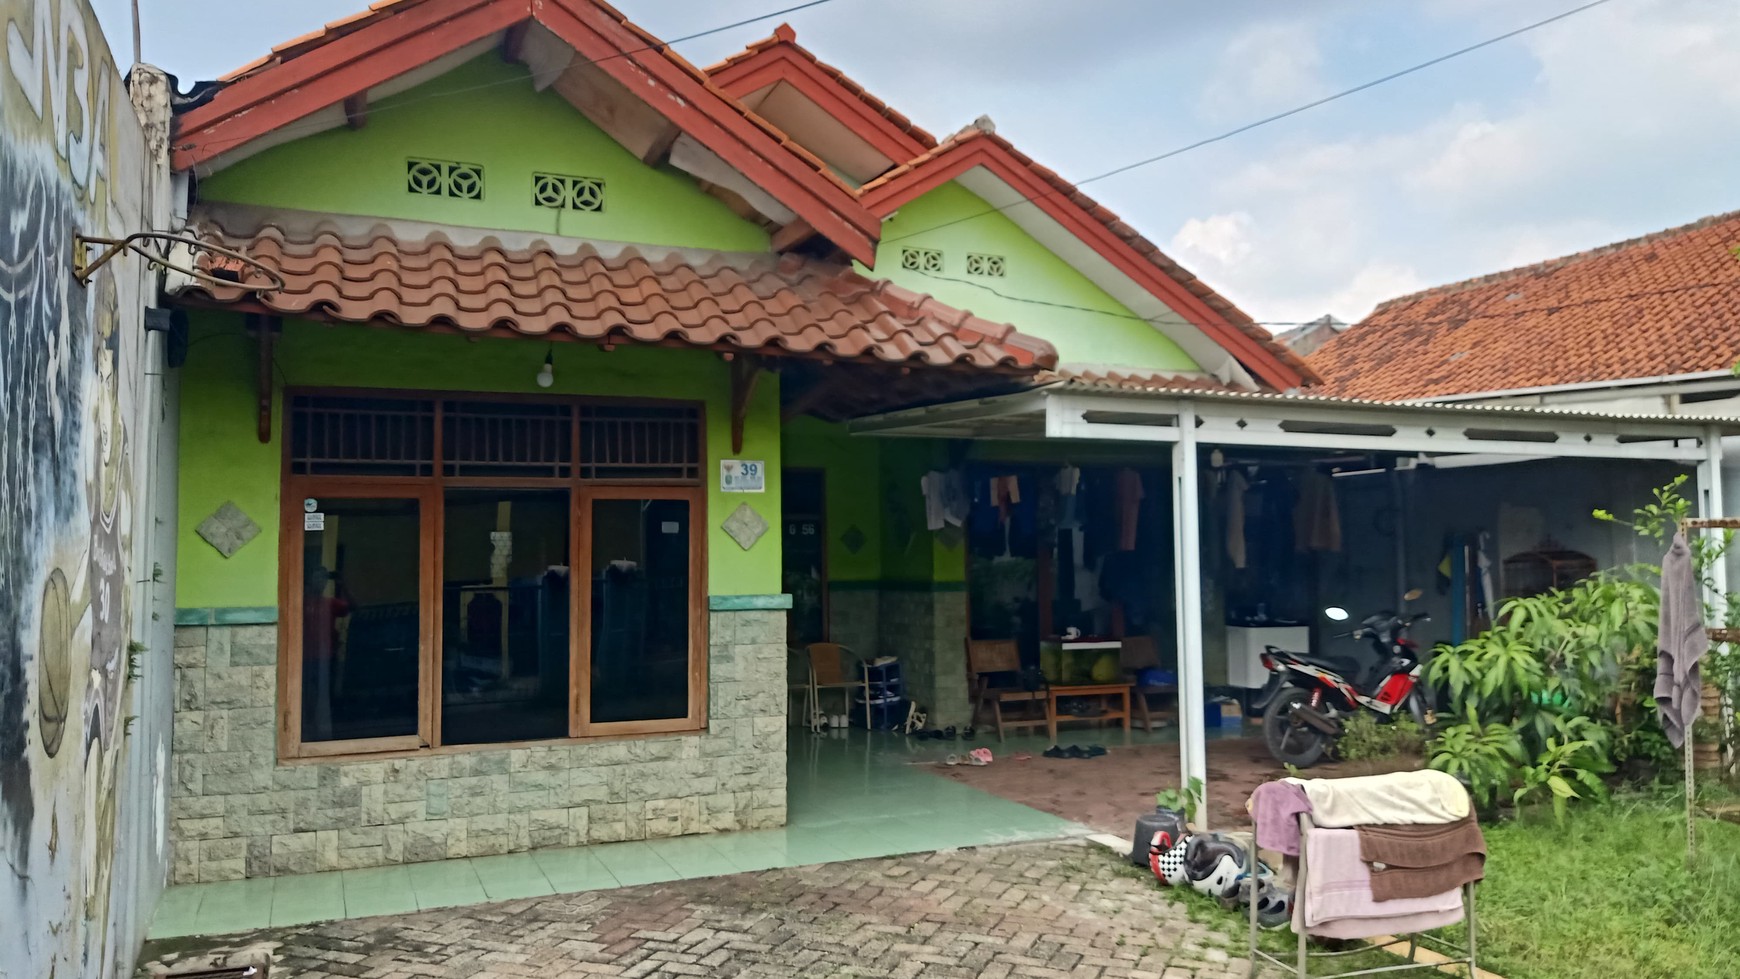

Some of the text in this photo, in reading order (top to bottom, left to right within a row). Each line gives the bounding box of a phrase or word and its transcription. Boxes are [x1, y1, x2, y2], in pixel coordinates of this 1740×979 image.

[740, 463, 758, 476] 39
[801, 523, 815, 535] 56
[99, 577, 110, 624] 30
